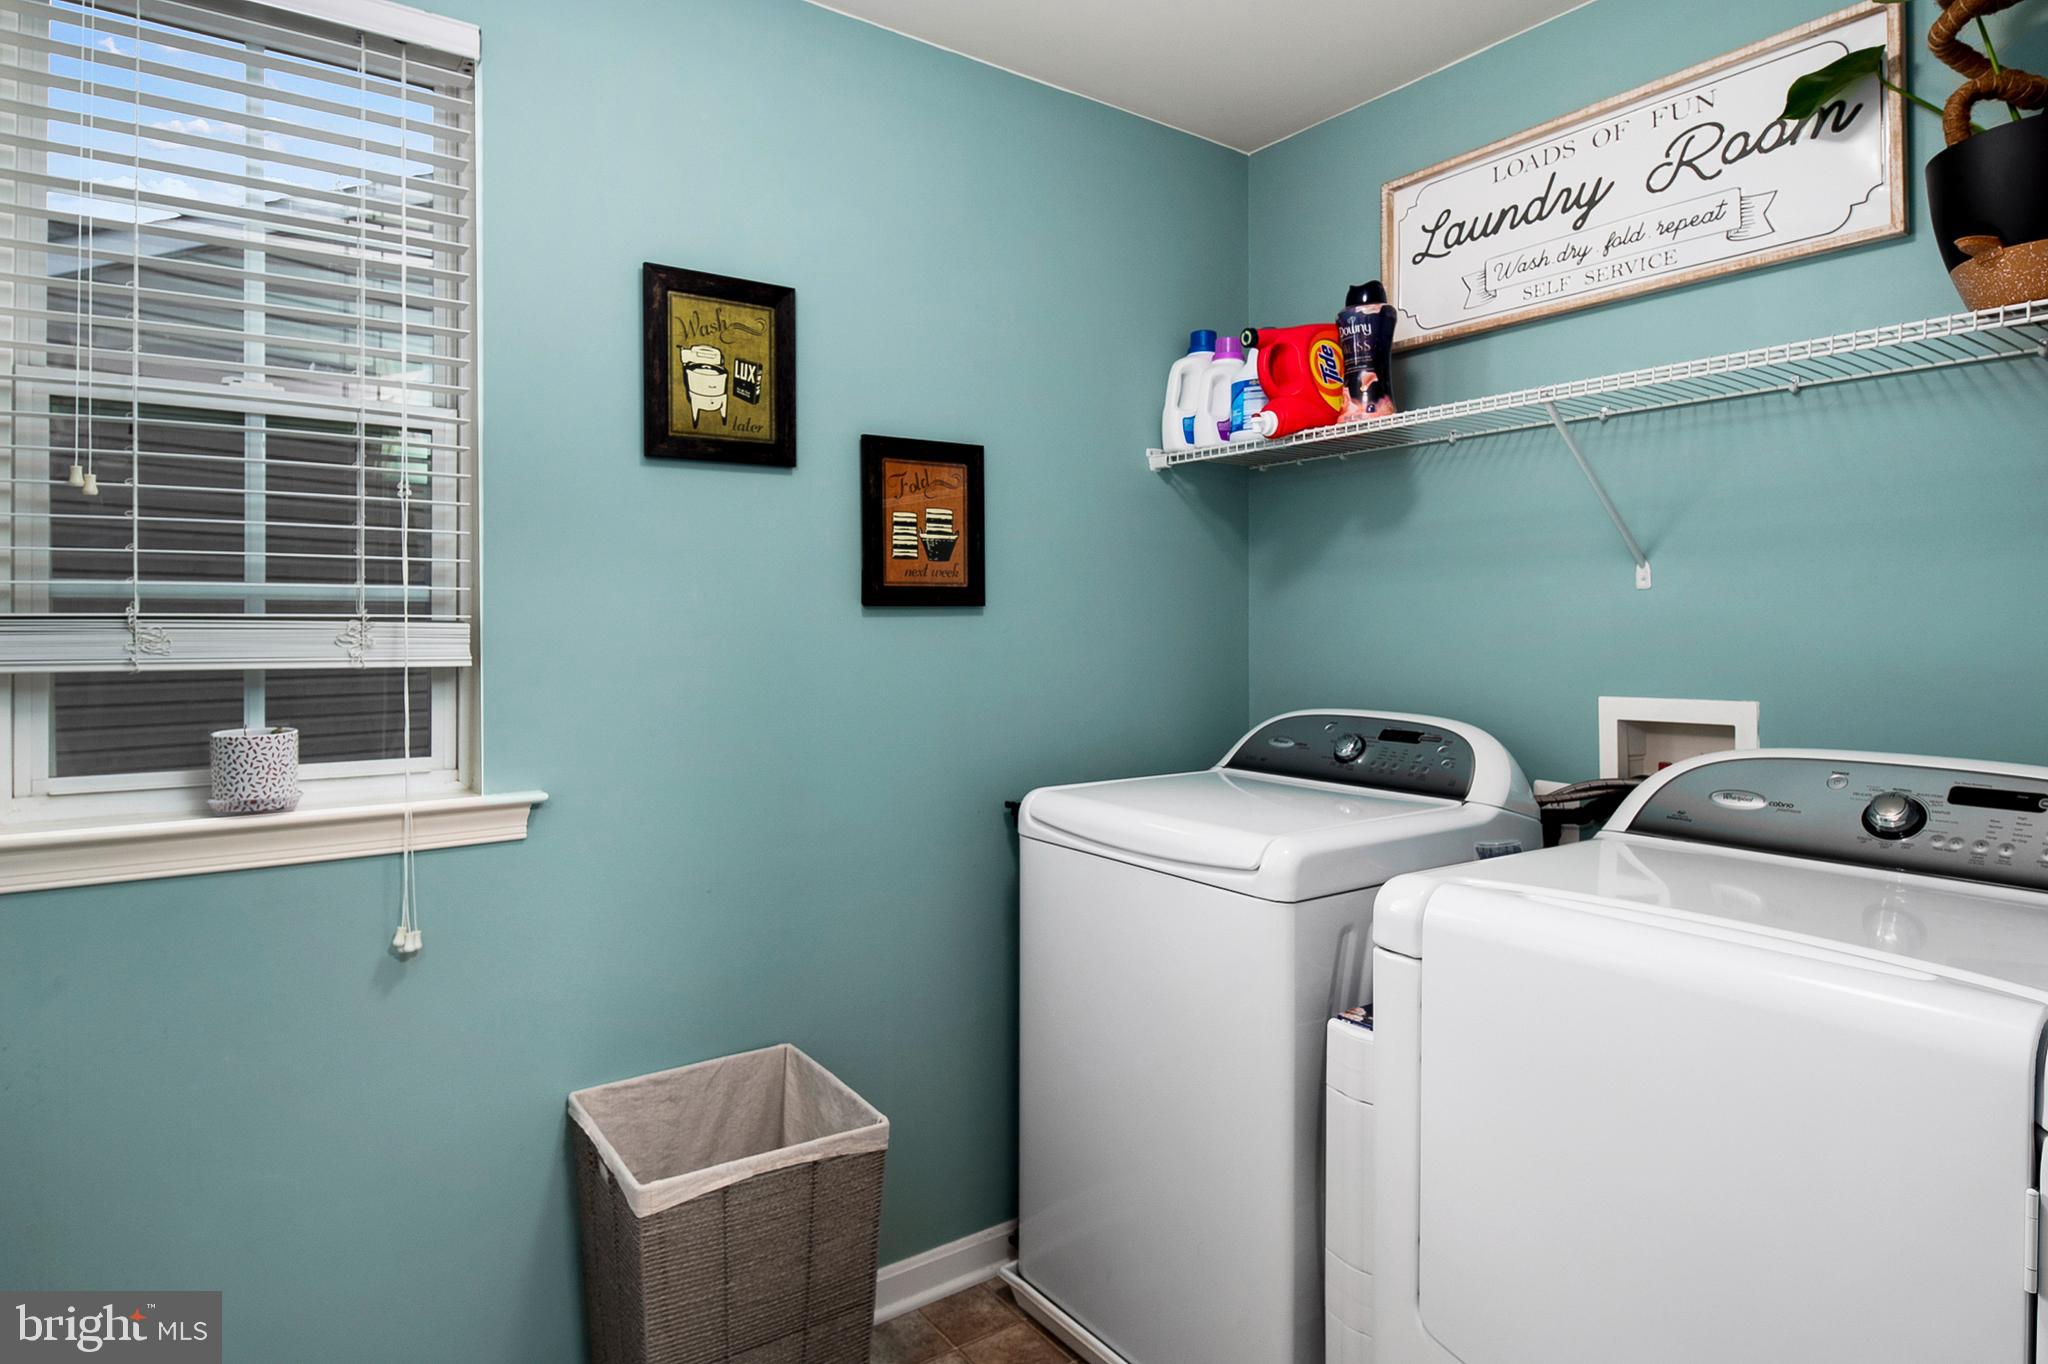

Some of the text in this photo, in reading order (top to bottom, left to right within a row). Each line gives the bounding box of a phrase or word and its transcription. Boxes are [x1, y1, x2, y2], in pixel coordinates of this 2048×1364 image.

[1492, 89, 1717, 184] LOADS OF FUN
[1411, 100, 1864, 265] Laundry Room
[1602, 222, 1646, 257] fold
[1656, 199, 1729, 240] repeat
[1522, 249, 1678, 301] SELF SERVICE
[674, 307, 735, 343] Wash
[734, 359, 756, 384] LUX
[1319, 344, 1344, 384] Tide
[732, 416, 764, 433] later
[889, 468, 933, 499] Fold
[904, 563, 960, 577] next week
